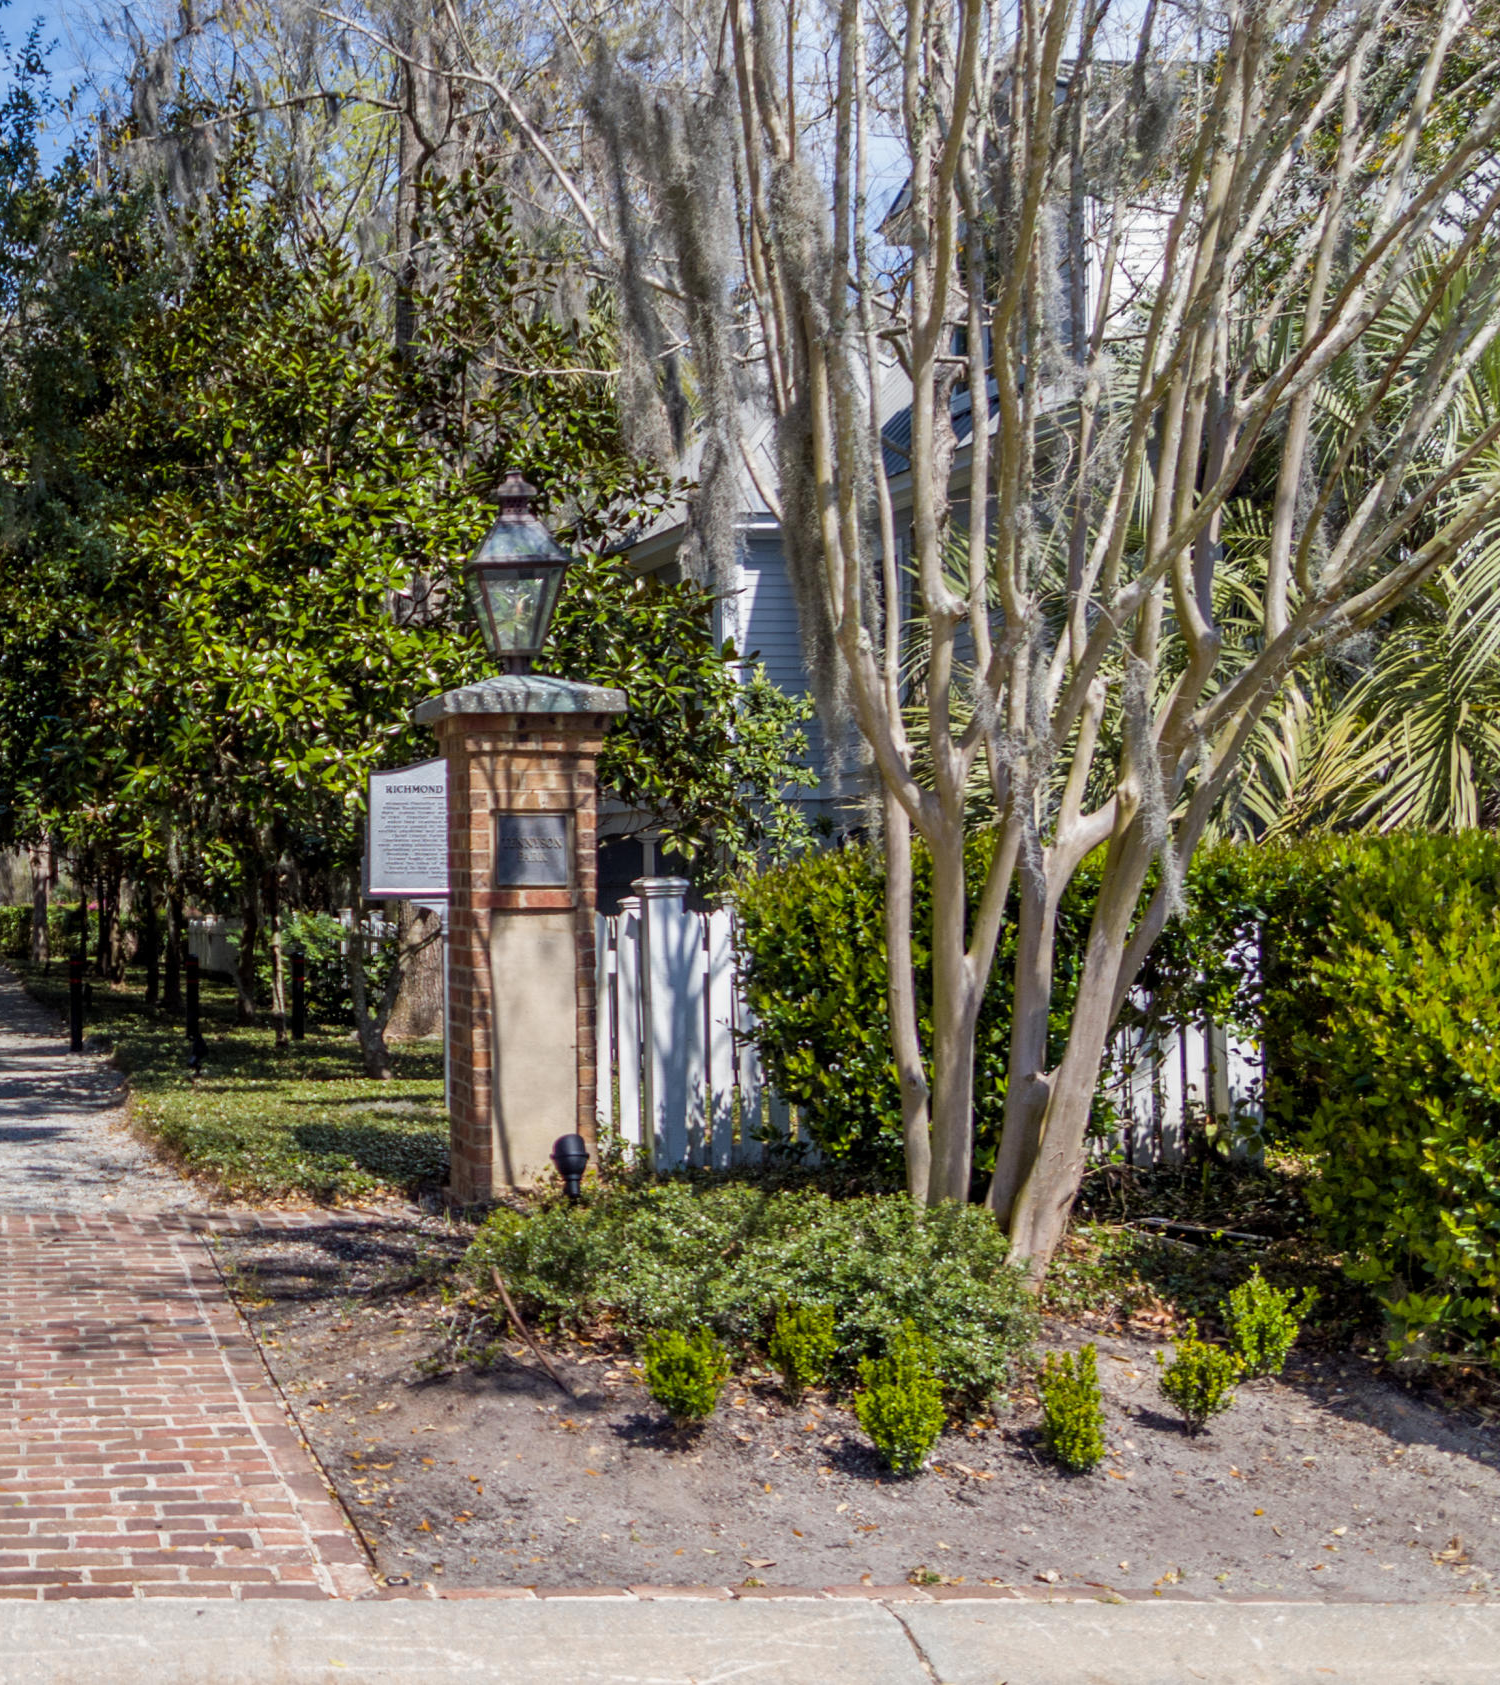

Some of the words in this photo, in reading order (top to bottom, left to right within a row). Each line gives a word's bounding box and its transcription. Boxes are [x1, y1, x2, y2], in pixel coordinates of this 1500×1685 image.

[385, 785, 444, 794] RICHMOND
[501, 837, 564, 849] TENNYSON
[518, 851, 549, 863] PARK
